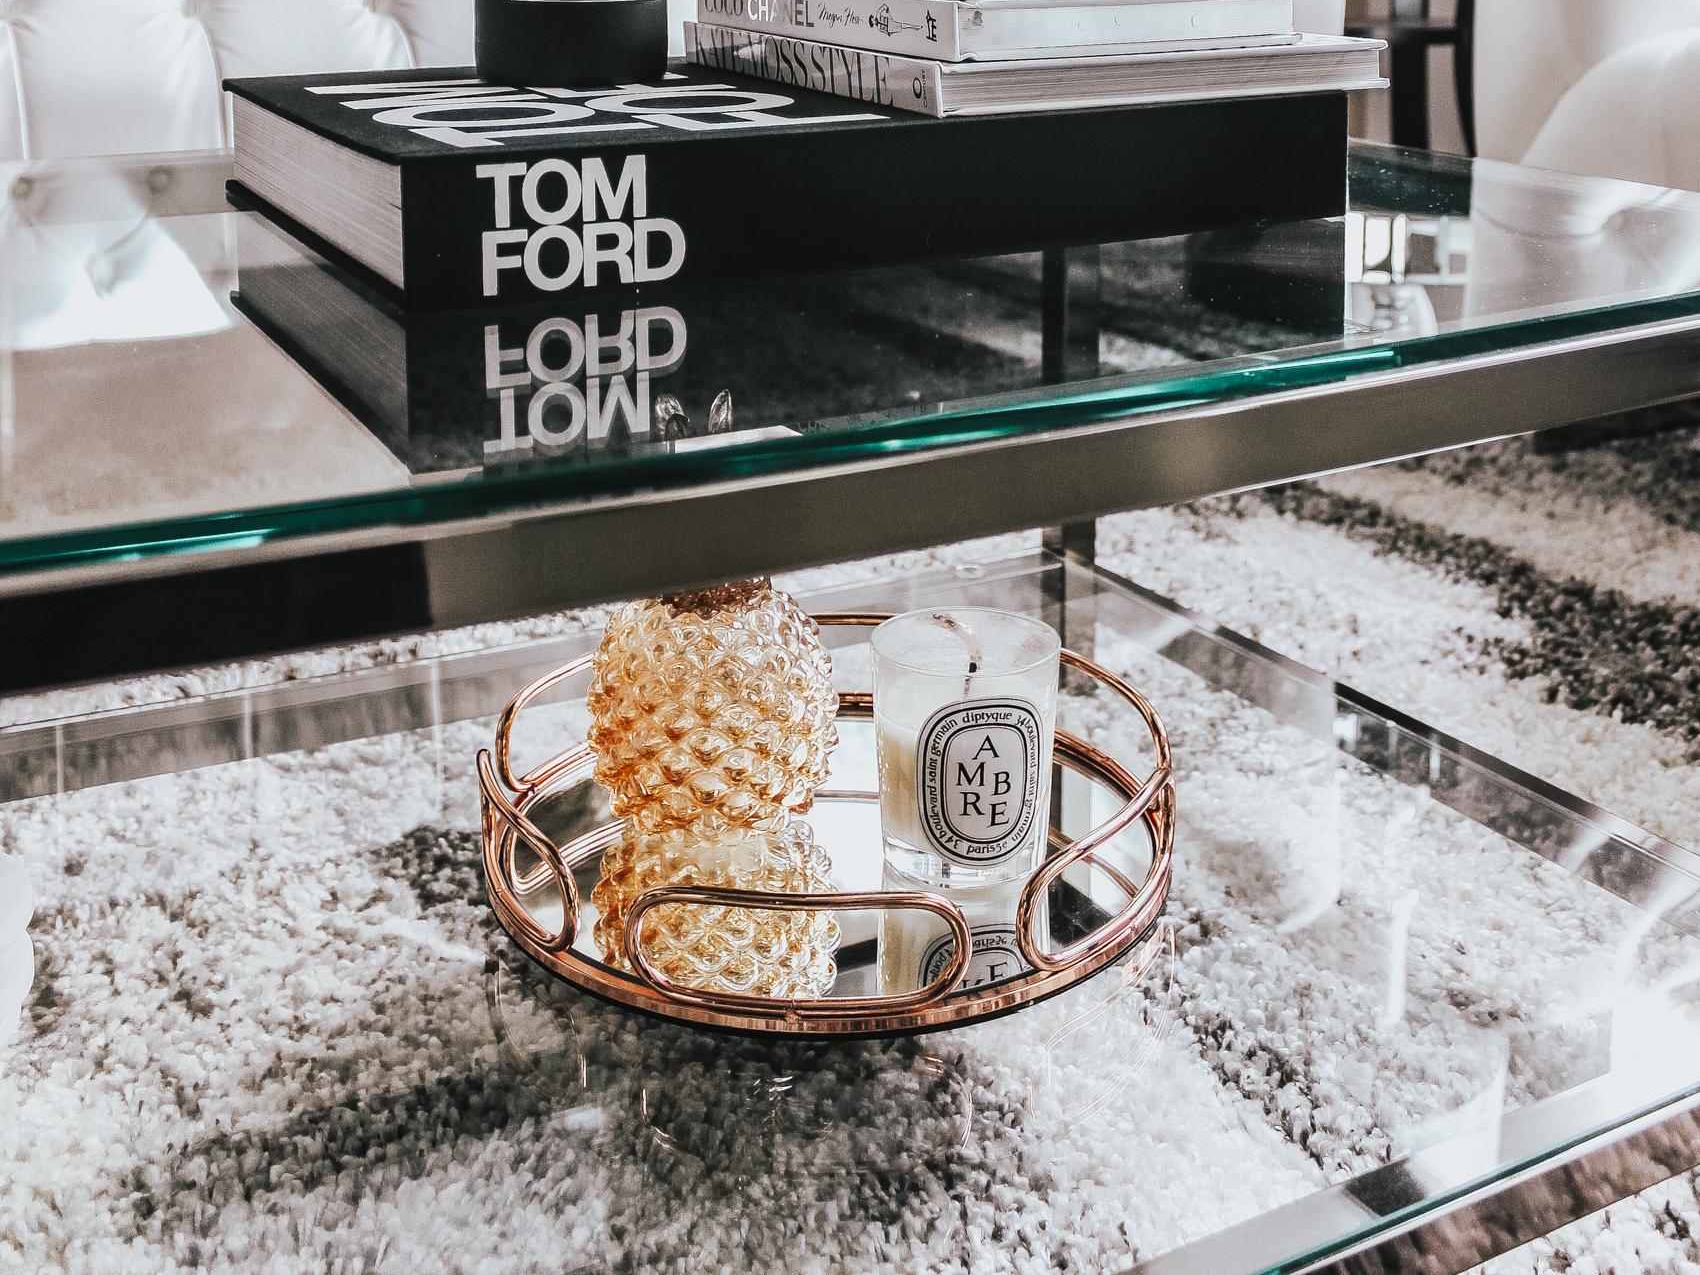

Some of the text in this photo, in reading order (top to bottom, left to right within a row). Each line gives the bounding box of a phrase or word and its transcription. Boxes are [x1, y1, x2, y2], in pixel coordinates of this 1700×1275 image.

[810, 43, 895, 108] STYLE
[476, 154, 646, 228] TOM
[482, 216, 686, 296] FORD
[930, 718, 959, 757] germain
[962, 711, 1012, 724] diptyque
[927, 757, 938, 784] saint
